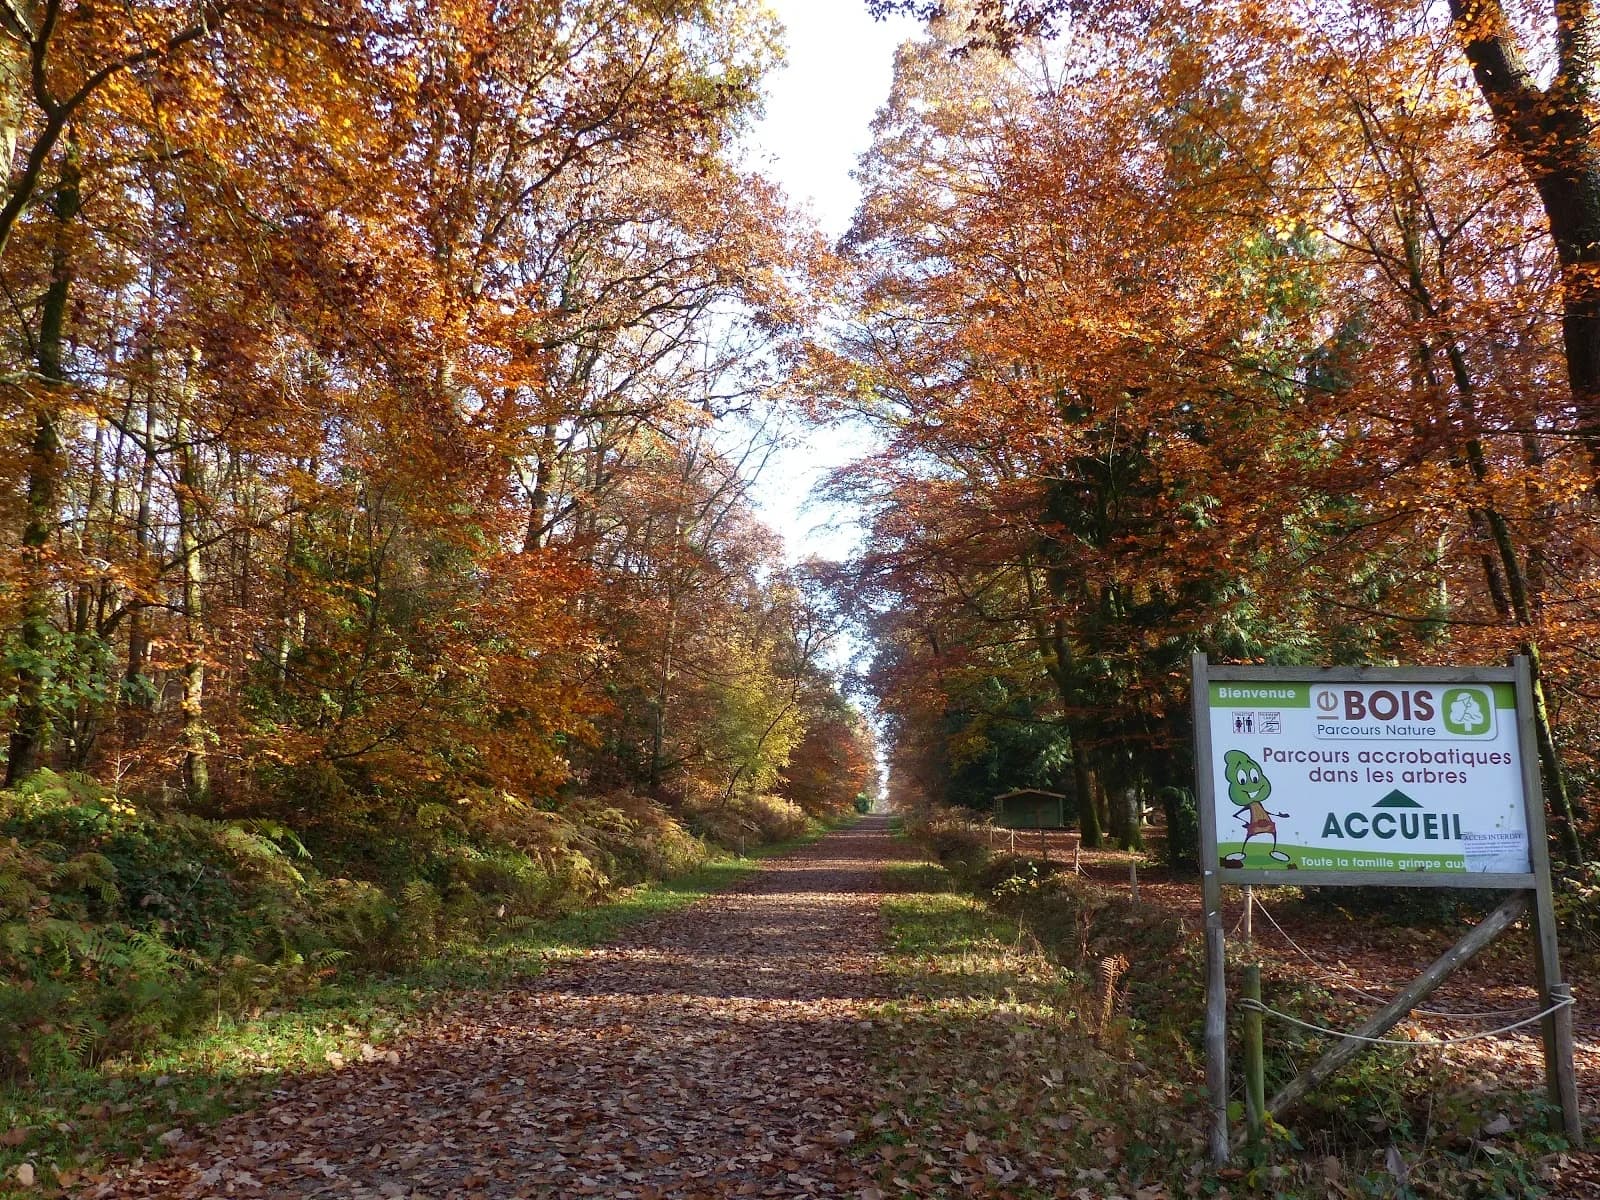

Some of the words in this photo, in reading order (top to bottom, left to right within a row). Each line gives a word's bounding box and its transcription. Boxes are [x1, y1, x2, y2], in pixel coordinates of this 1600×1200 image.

[1219, 687, 1296, 699] Bienvenue
[1343, 690, 1435, 722] BOIS
[1317, 724, 1381, 735] Parcours
[1386, 724, 1436, 736] Nature
[1263, 747, 1349, 763] Parcours
[1357, 749, 1512, 768] accrobatiques
[1309, 768, 1358, 783] dans
[1366, 768, 1394, 783] les
[1402, 769, 1467, 784] arbres
[1321, 812, 1467, 840] ACCUEIL
[1301, 856, 1333, 868] Toute
[1337, 857, 1349, 868] la
[1352, 857, 1394, 869] famille
[1398, 858, 1441, 870] grimpe
